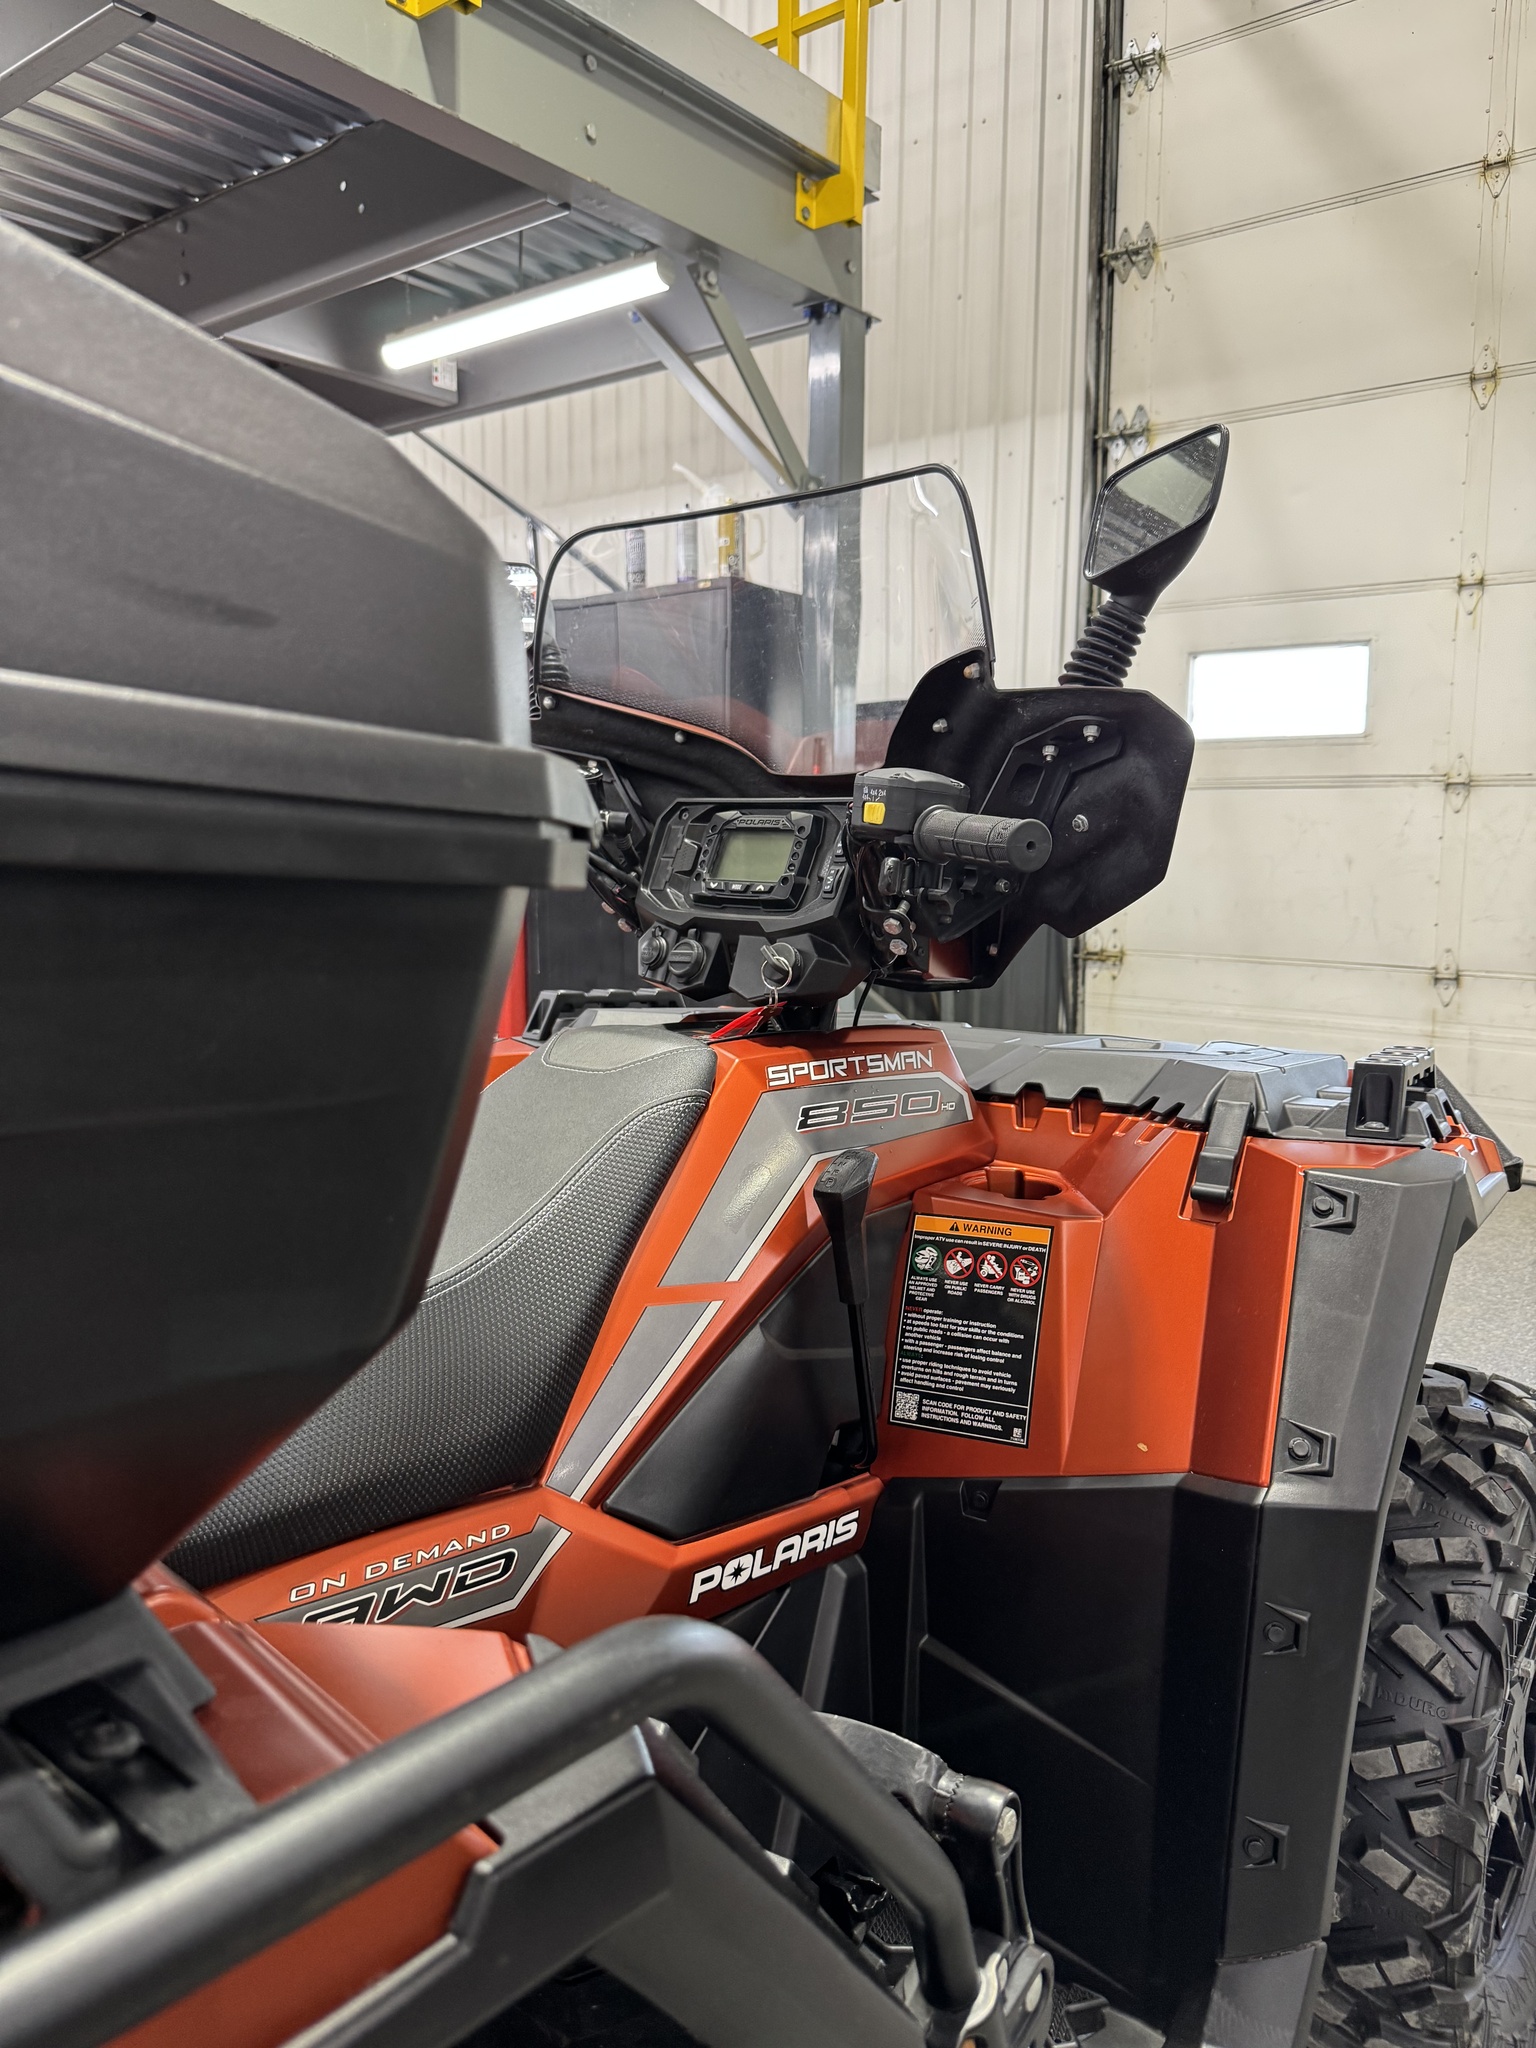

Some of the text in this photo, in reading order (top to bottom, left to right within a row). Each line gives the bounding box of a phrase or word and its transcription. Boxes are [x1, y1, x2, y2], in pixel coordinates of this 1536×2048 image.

[767, 1050, 933, 1087] SPORTSMAN
[796, 1090, 941, 1132] 850
[962, 1223, 1012, 1236] WARNING
[947, 1345, 975, 1353] passengers
[944, 1363, 970, 1372] techniques
[914, 1379, 934, 1387] handling
[954, 1380, 979, 1388] pavement
[992, 1384, 1016, 1393] seriously
[921, 1405, 958, 1416] INFORMATION.
[960, 1412, 983, 1420] FOLLOW
[965, 1406, 991, 1415] PRODUCT
[1004, 1412, 1026, 1420] SAFETY
[920, 1412, 959, 1423] INSTRUCTIONS
[972, 1420, 1002, 1430] WARNINGS.
[289, 1524, 512, 1602] ON DEMAND
[689, 1510, 860, 1604] POLARIS
